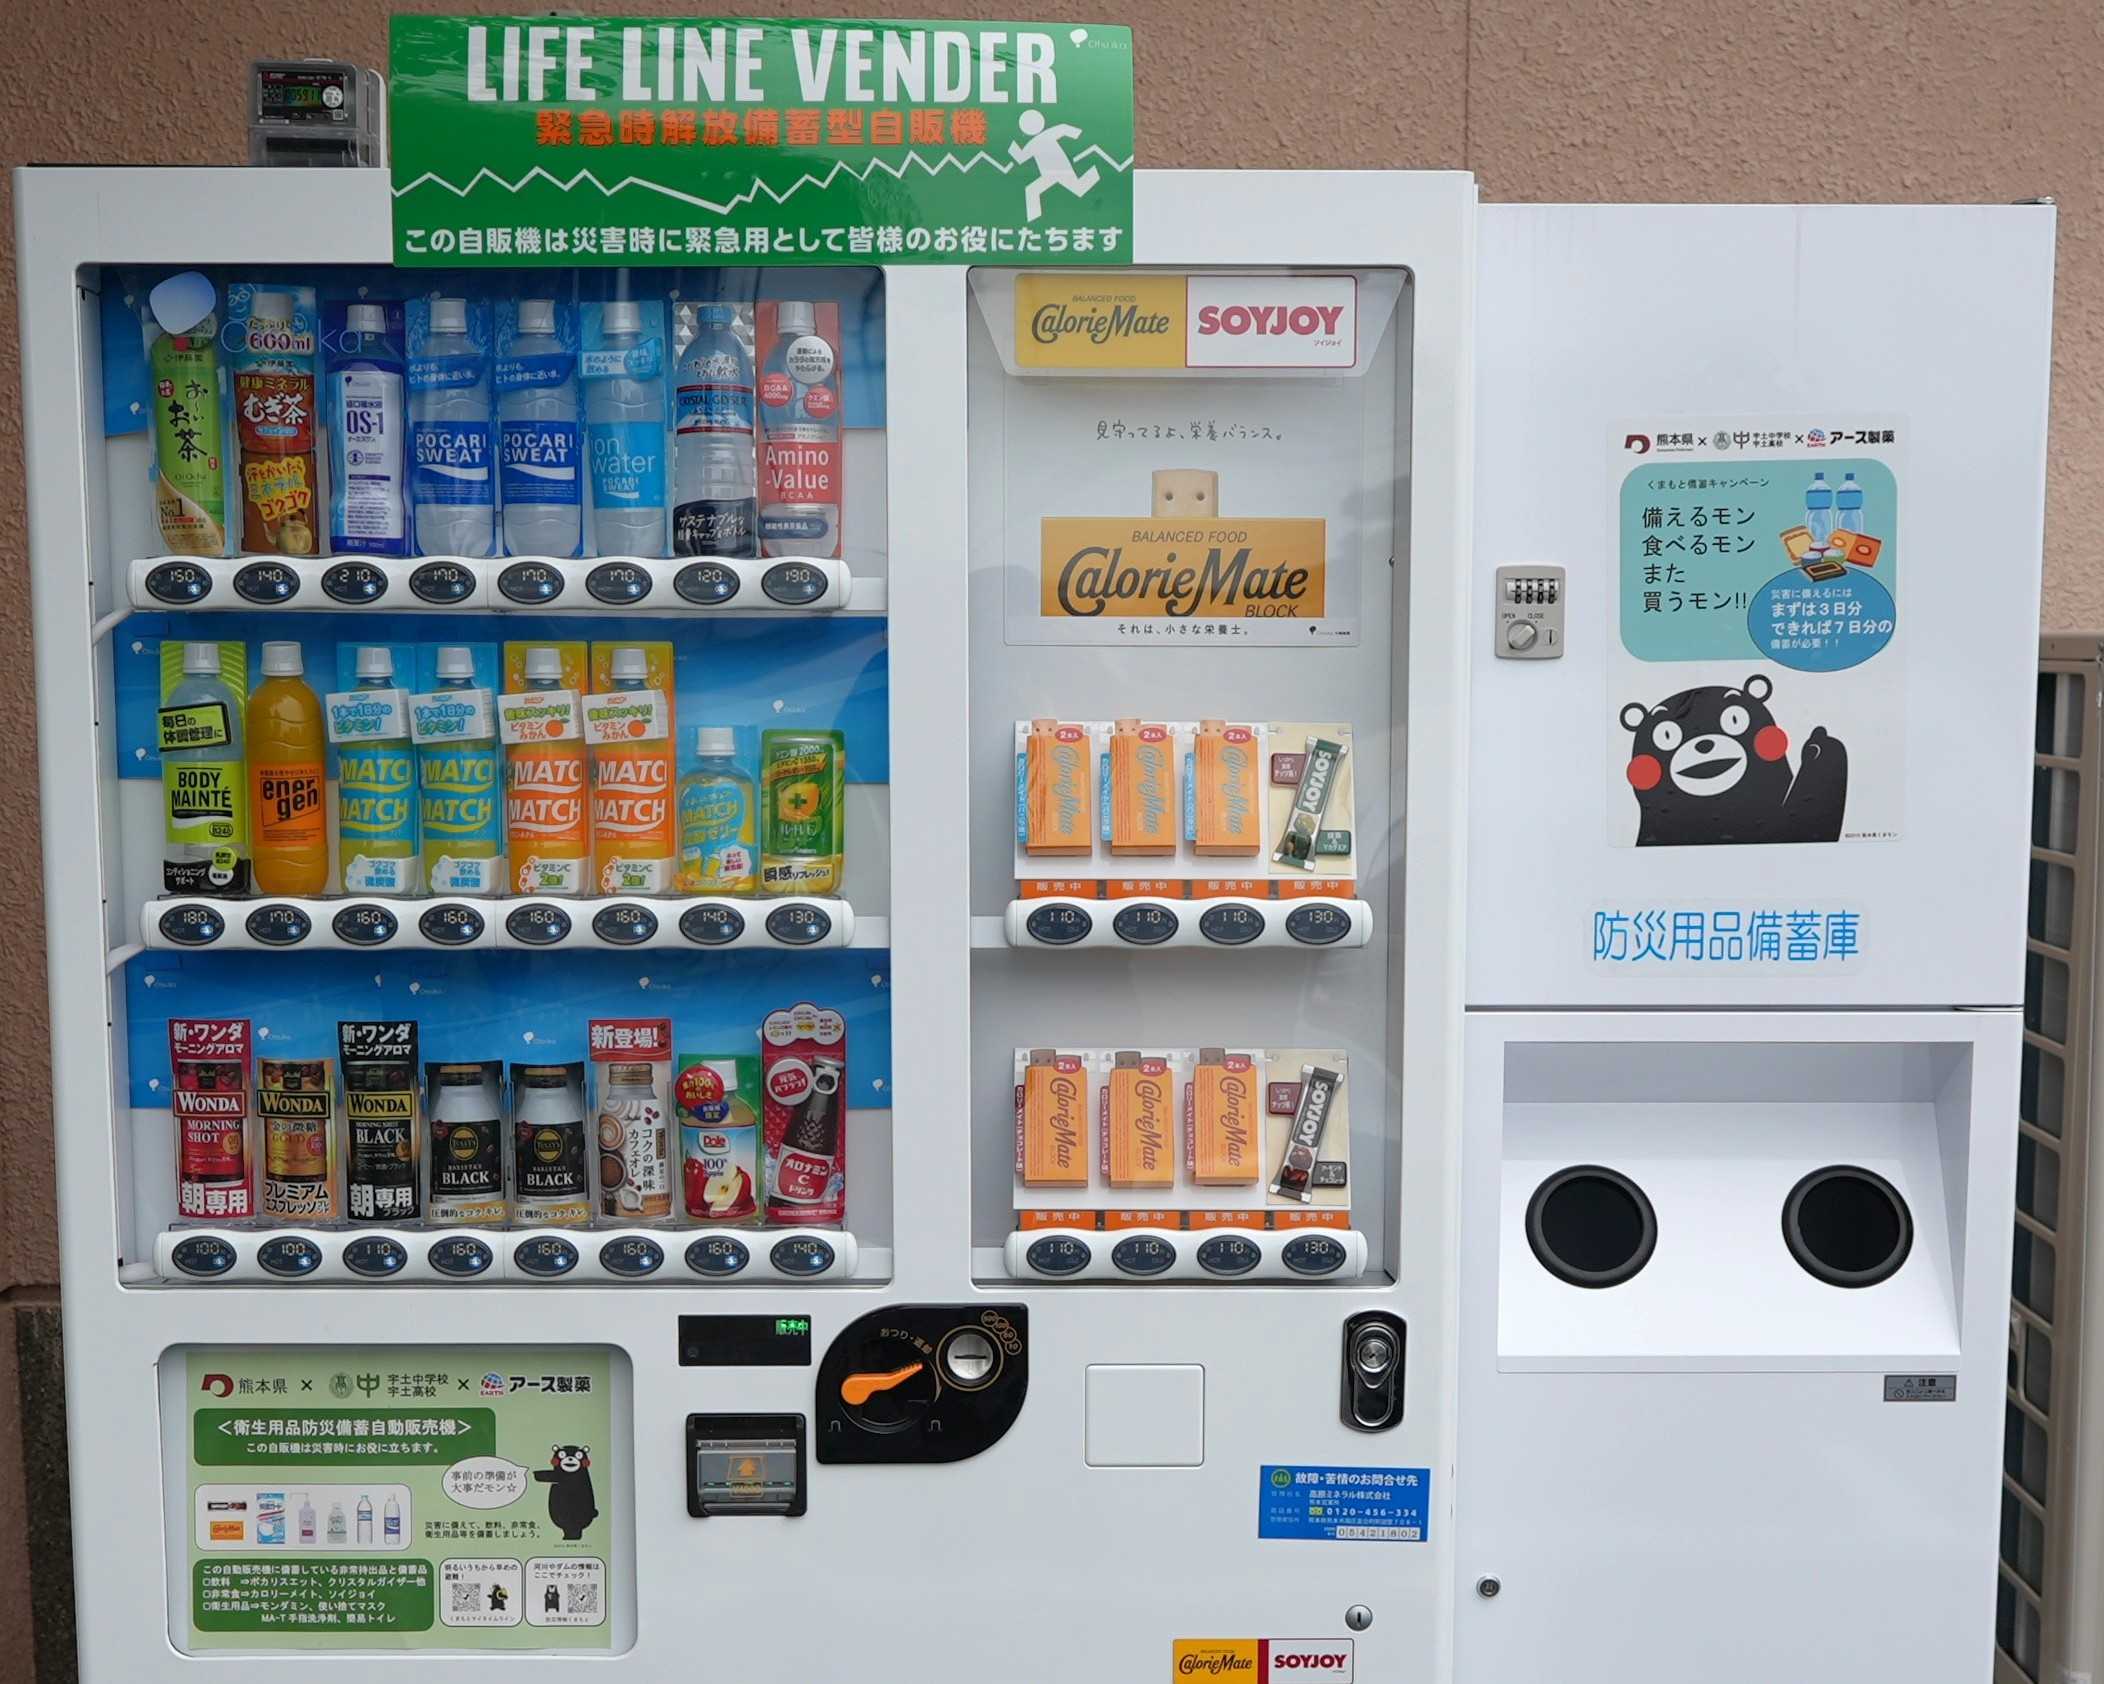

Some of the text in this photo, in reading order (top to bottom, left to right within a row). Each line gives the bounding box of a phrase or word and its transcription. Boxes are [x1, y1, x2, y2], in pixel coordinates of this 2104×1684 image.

[466, 26, 1057, 103] LIFE LINE VENDER
[536, 108, 988, 146] 緊急時解放備蓄型自販機
[405, 225, 1122, 255] この自販機は災害時に緊急用として皆様のお役にたちます
[1032, 303, 1170, 344] CalorieMate
[1197, 305, 1344, 336] SOYJOY
[250, 332, 312, 351] 600ml
[243, 393, 308, 424] むぎ茶
[167, 400, 208, 462] お茶
[346, 410, 384, 436] OS-1
[415, 433, 487, 448] POCARI
[503, 433, 573, 448] POCARI
[1657, 433, 1693, 446] 熊本県
[1830, 430, 1894, 445] アース製薬
[415, 448, 482, 464] SWEAT
[503, 448, 568, 464] SWEAT
[765, 445, 829, 466] Amino
[591, 456, 657, 474] water
[1648, 478, 1770, 490] くまもと備蓄キャンペーン
[1642, 506, 1756, 529] 備えるモン
[1132, 530, 1248, 543] BALANCED FOOD
[1642, 534, 1756, 557] 食べるモン
[339, 569, 370, 583] 210
[784, 569, 810, 583] 190
[1057, 546, 1309, 617] CalorieMate
[1643, 563, 1686, 584] また
[1643, 591, 1747, 613] 買うモン!!
[1771, 588, 1852, 600] 災害に備えるには
[1245, 604, 1298, 617] BLOCK
[178, 771, 221, 788] BODY
[262, 777, 316, 798] ener
[1302, 750, 1332, 812] SOYJOY
[171, 786, 232, 809] MAINTÉ
[277, 789, 318, 822] gen
[183, 911, 207, 924] 180
[357, 911, 381, 924] 160
[444, 911, 468, 924] 160
[530, 911, 554, 924] 160
[617, 911, 641, 924] 160
[789, 911, 814, 924] 130
[1050, 911, 1074, 924] 110
[1136, 911, 1160, 924] 110
[1223, 911, 1247, 924] 110
[1309, 911, 1333, 924] 130
[1594, 909, 1861, 961] 防災用品備蓄庫
[173, 1023, 243, 1043] 新・ワンダ
[342, 1023, 412, 1043] 新・ワンダ
[591, 1024, 659, 1049] 新登場!
[174, 1043, 244, 1056] モーニングアロマ
[343, 1043, 413, 1056] モーニングアロマ
[178, 1092, 241, 1113] WONDA
[262, 1093, 324, 1113] WONDA
[351, 1093, 408, 1113] WONDA
[1220, 1076, 1247, 1167] CalorieMate
[1299, 1081, 1329, 1146] SOYJOY
[187, 1119, 241, 1131] MORNING
[1049, 1077, 1077, 1169] CalorieMate
[1135, 1080, 1162, 1171] CalorieMate
[187, 1131, 220, 1144] SHOT
[355, 1128, 408, 1145] BLACK
[703, 1135, 726, 1146] Dole
[628, 1128, 641, 1178] カフェオレ
[642, 1128, 656, 1191] コクの深味
[785, 1158, 828, 1177] オロナミン
[441, 1171, 490, 1185] BLACK
[527, 1173, 574, 1187] BLACK
[797, 1175, 809, 1185] C
[264, 1183, 330, 1200] プレミアム
[181, 1183, 249, 1217] 朝専用
[350, 1183, 413, 1217] 朝専用
[367, 1243, 390, 1256] 110
[453, 1243, 477, 1256] 160
[538, 1243, 562, 1256] 160
[624, 1243, 648, 1256] 160
[709, 1243, 733, 1256] 160
[1050, 1242, 1074, 1255] 110
[1135, 1242, 1159, 1255] 110
[1220, 1242, 1244, 1255] 110
[1304, 1242, 1329, 1255] 130
[239, 1378, 289, 1395] 熊本県
[509, 1376, 592, 1393] アース製薬
[246, 1442, 439, 1455] この自販機は災害時にお役に立ちます。
[451, 1470, 517, 1481] 事前の準備が
[1296, 1472, 1419, 1488] 故障・苦情のお問合せ先
[1179, 1653, 1348, 1676] CalorieMate SOYJOY
